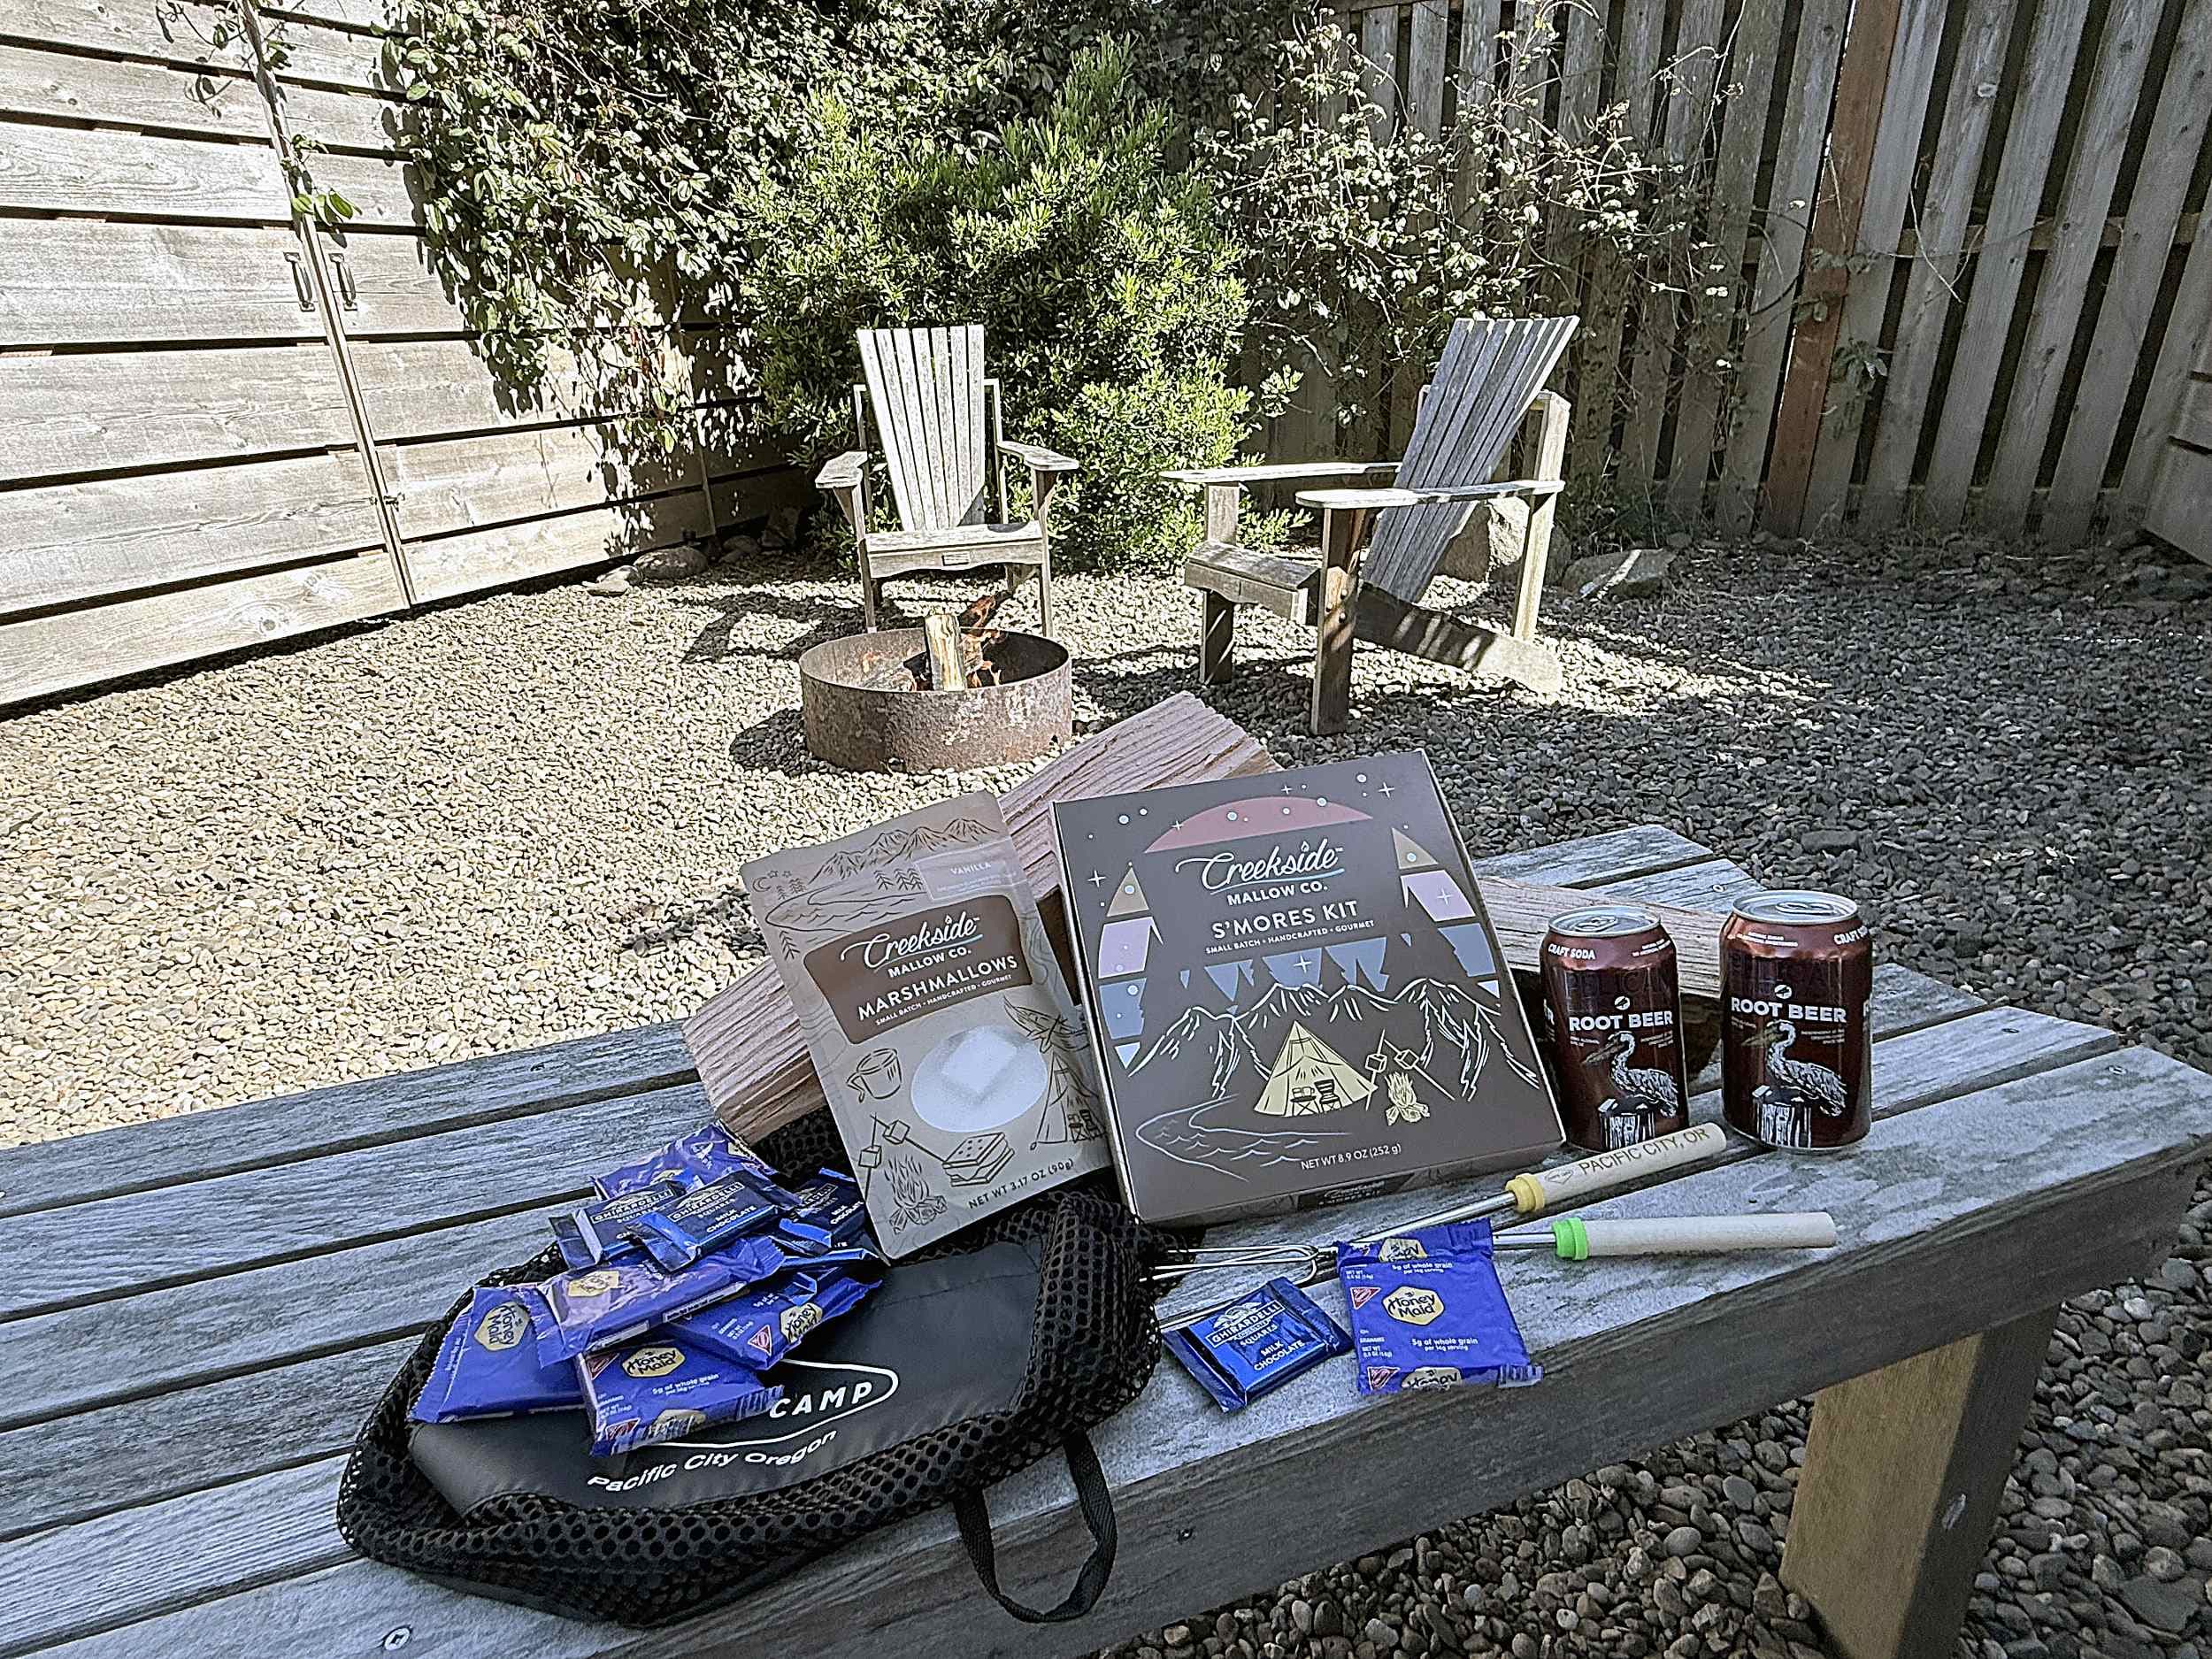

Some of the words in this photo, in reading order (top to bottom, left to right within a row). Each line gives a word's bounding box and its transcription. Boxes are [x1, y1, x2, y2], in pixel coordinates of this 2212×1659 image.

[950, 861, 992, 875] VANILLA
[1175, 838, 1341, 890] Creekside
[1227, 883, 1295, 906] MALLOW
[1300, 880, 1328, 893] CO.
[1212, 907, 1316, 939] S'MORES
[1323, 900, 1357, 921] KIT
[841, 910, 979, 969] Creekside
[1205, 943, 1233, 955] SMALL
[1233, 938, 1261, 949] BATCH
[1267, 927, 1328, 944] HANDCRAFTED
[1334, 919, 1375, 933] GOURMET
[1548, 943, 1570, 956] CRAFT
[1570, 948, 1596, 960] SODA
[887, 952, 945, 979] MALLOW
[948, 946, 972, 959] CO.
[857, 955, 1018, 1021] MARSHMALLOWS
[876, 1013, 898, 1025] SMALL
[898, 1002, 922, 1017] BATCH
[926, 984, 977, 1006] HANDCRAFTED
[980, 974, 1012, 987] GOURMET
[1569, 1015, 1623, 1032] ROOT
[1628, 1010, 1673, 1028] BEER
[1731, 996, 1783, 1018] ROOT
[1788, 1003, 1847, 1023] BEER
[1301, 1157, 1320, 1171] NET
[1321, 1155, 1336, 1167] WT
[1337, 1152, 1352, 1164] 8.9
[1354, 1148, 1368, 1160] OZ
[1369, 1144, 1390, 1159] (252
[1391, 1143, 1402, 1156] g)
[1578, 1147, 1642, 1175] PACIFIC
[1643, 1136, 1685, 1156] CITY,
[1684, 1127, 1710, 1144] OR
[968, 1194, 990, 1210] NET
[991, 1185, 1009, 1198] WT
[1011, 1176, 1028, 1191] 3.17
[1031, 1170, 1047, 1181] OZ
[1048, 1158, 1074, 1175] (90g)
[706, 1205, 757, 1233] CHOCOLATE
[715, 1209, 737, 1221] MILK
[1387, 1294, 1435, 1315] Honey
[1398, 1303, 1435, 1317] Maid
[488, 1314, 501, 1345] Maid
[494, 1304, 516, 1345] Honey
[1211, 1302, 1282, 1343] GHIRARDELLI
[1240, 1323, 1279, 1347] SQUARES
[1254, 1340, 1306, 1371] CHOCOLATE
[1260, 1340, 1284, 1356] MILK
[1411, 1338, 1422, 1347] 5g
[1433, 1337, 1456, 1346] whole
[1458, 1337, 1479, 1346] grain
[627, 1349, 676, 1374] Honey
[637, 1357, 677, 1375] Maid
[769, 1380, 873, 1418] CAMP
[588, 1463, 677, 1492] Pacific
[683, 1451, 739, 1471] City
[744, 1429, 837, 1467] Oregon
